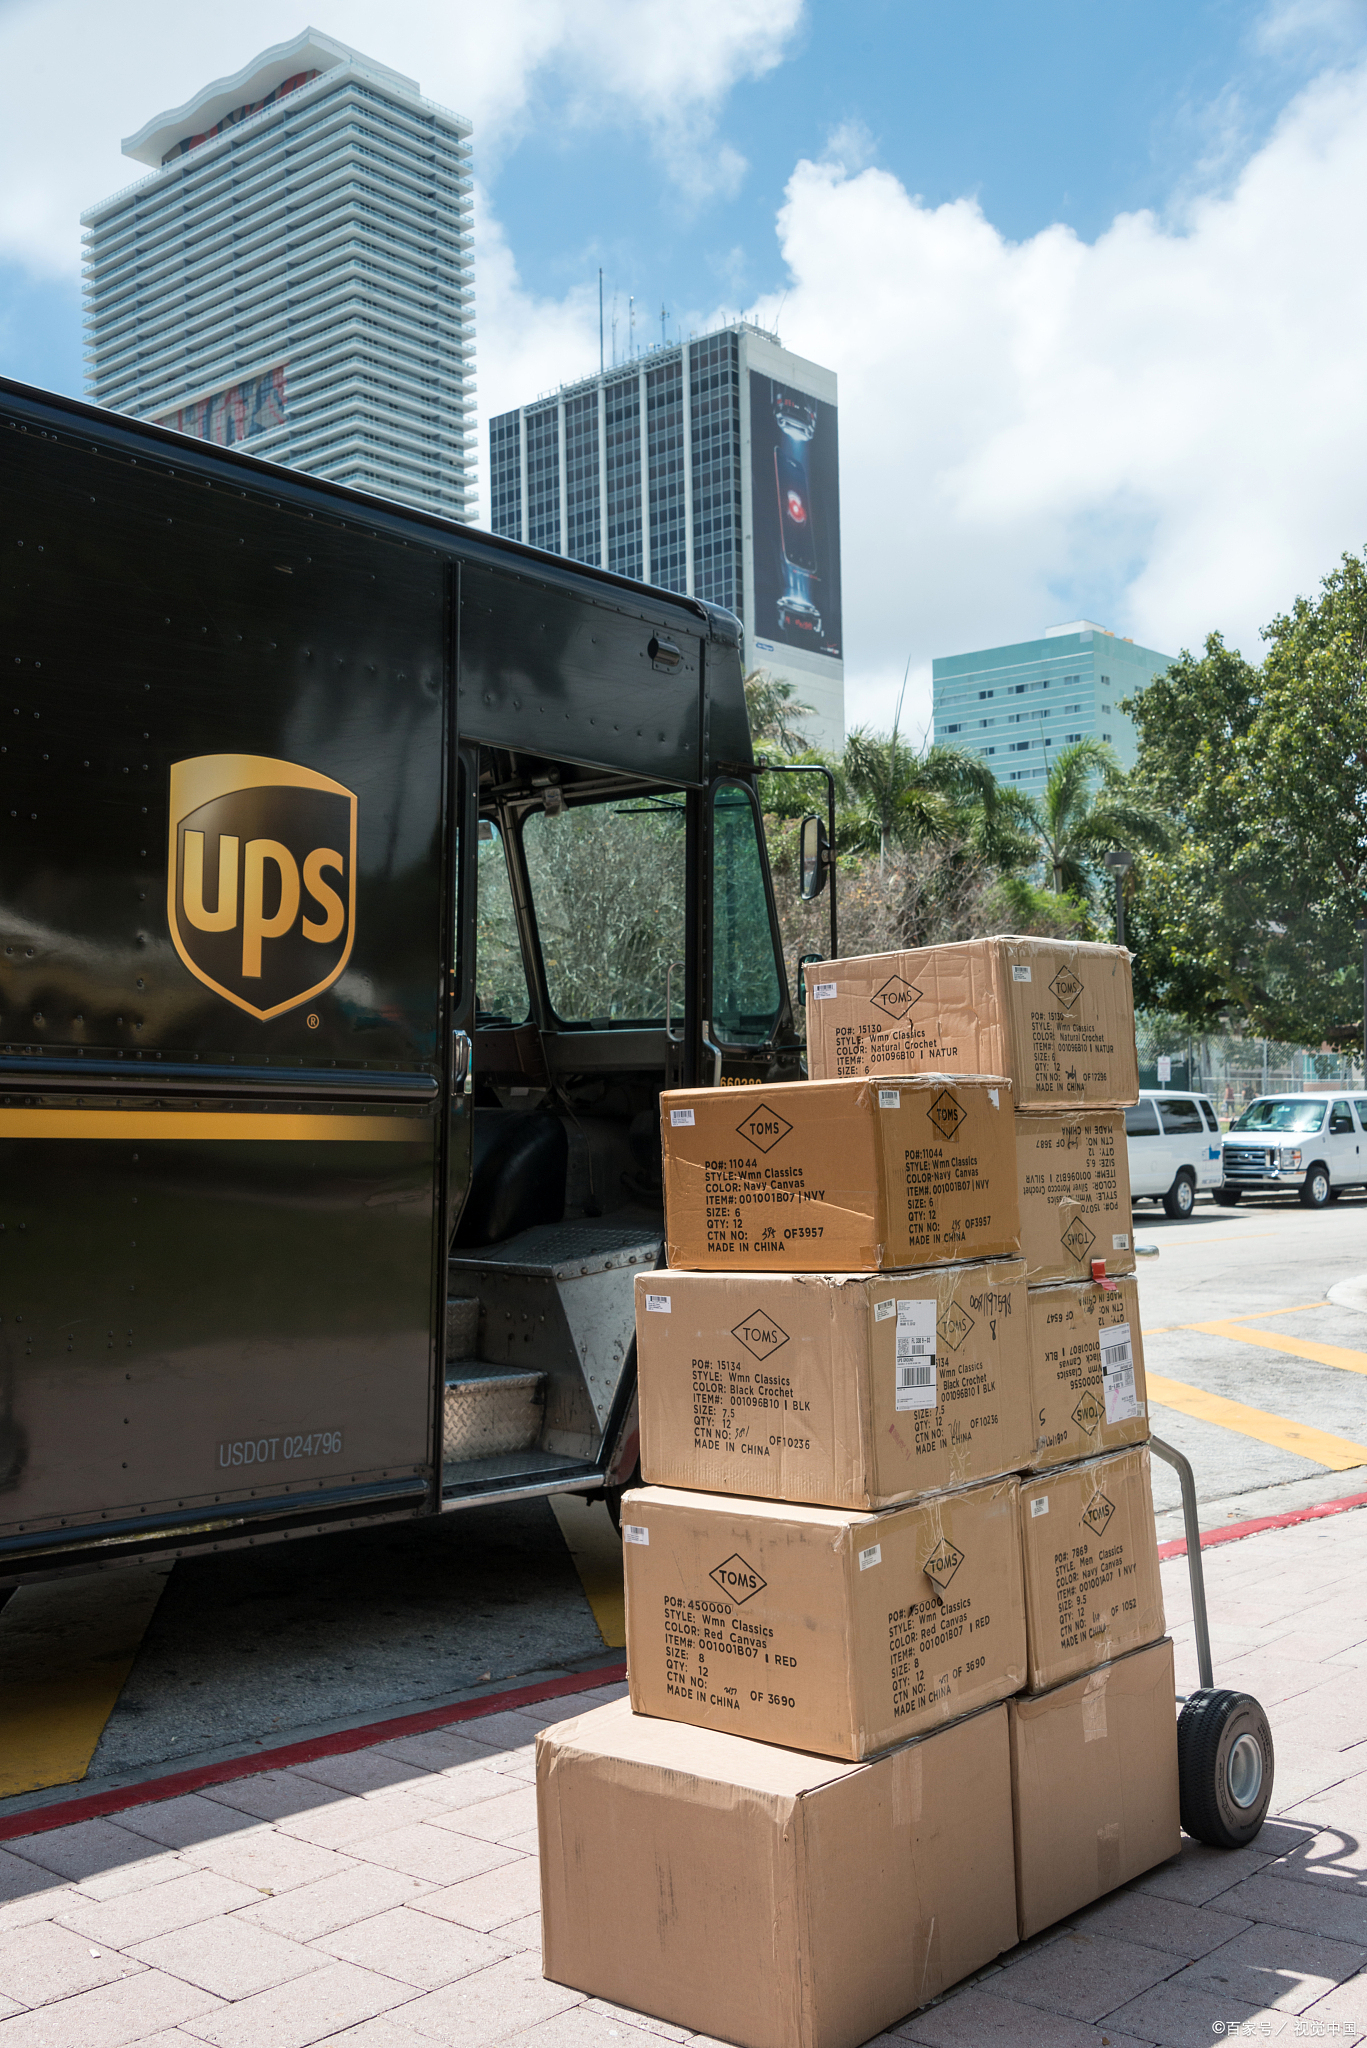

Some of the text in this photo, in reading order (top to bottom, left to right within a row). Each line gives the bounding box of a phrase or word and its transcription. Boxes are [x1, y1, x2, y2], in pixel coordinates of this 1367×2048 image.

[183, 829, 344, 978] ups
[880, 991, 912, 1006] TOMS
[836, 1024, 882, 1036] PO#: 15130
[870, 1030, 925, 1042] Wmn Classics
[1082, 1034, 1104, 1042] Crochet
[837, 1040, 937, 1056] COLOR: Natural Crochet
[871, 1047, 958, 1062] 001096B10 NATUR
[838, 1067, 858, 1075] SIZE:
[1036, 1083, 1084, 1091] MADE CHINA
[937, 1109, 958, 1120] TOMS
[750, 1122, 779, 1135] TOMS
[705, 1161, 726, 1170] PO#:
[932, 1156, 977, 1170] Wmn Classics
[705, 1167, 803, 1181] STYLE: Wmn Classics
[955, 1169, 978, 1178] Canvas
[1026, 1175, 1044, 1183] SILVR
[706, 1179, 804, 1192] COLOR: Navy Canvas
[933, 1180, 989, 1195] 001001B07 NVY
[1023, 1183, 1088, 1195] Silver Morocco Crochet
[706, 1190, 825, 1205] ITEM#: 001001B07 NVY
[908, 1199, 926, 1209] SIZE:
[706, 1208, 730, 1217] SIZE:
[1081, 1204, 1100, 1213] 15070
[707, 1219, 742, 1228] QTY: 12
[909, 1212, 925, 1221] QTY:
[909, 1223, 923, 1233] CTN
[708, 1231, 747, 1240] CTN NO:
[910, 1232, 966, 1246] MADE IN CHINA
[1068, 1233, 1089, 1246] TOMS
[708, 1242, 785, 1252] MADE IN CHINA
[1107, 1292, 1122, 1301] MADE
[1047, 1311, 1073, 1323] OF 6547
[942, 1319, 966, 1334] TOMS
[743, 1328, 777, 1343] TOMS
[1045, 1352, 1058, 1361] BLK
[1059, 1355, 1081, 1368] Canvas
[692, 1359, 741, 1370] PO#: 15134
[959, 1362, 983, 1374] Classics
[692, 1371, 790, 1386] STYLE: Wmn Classics
[1057, 1367, 1082, 1380] Classics
[944, 1374, 987, 1390] Black Crochet
[693, 1382, 793, 1398] COLOR: Black Crochet
[941, 1382, 995, 1402] 001096B10 BLK
[694, 1393, 810, 1411] ITEM#: 001096B10 BLK
[694, 1405, 716, 1415] SIZE:
[1077, 1407, 1099, 1421] TOMS
[694, 1416, 714, 1426] QTY:
[694, 1428, 712, 1437] CTN
[716, 1430, 731, 1439] NO:
[220, 1432, 341, 1466] USDOT 024796
[695, 1439, 770, 1456] MADE IN CHINA
[916, 1438, 947, 1454] MADE IN
[1072, 1545, 1088, 1558] 7869
[1080, 1545, 1123, 1567] Men Classics
[930, 1553, 957, 1573] TOMS
[1082, 1557, 1122, 1581] Navy Canvas
[1124, 1563, 1136, 1576] NVY
[719, 1570, 756, 1588] TOMS
[664, 1596, 731, 1614] PO#: 450000
[1058, 1600, 1073, 1613] SIZE:
[1122, 1599, 1136, 1612] 1052
[665, 1608, 773, 1637] STYLE: Wmn Classics
[889, 1599, 971, 1638] STYLE: Wmn Classics
[665, 1621, 767, 1648] COLOR: Red Canvas
[890, 1613, 967, 1651] COLOR: Red Canvas
[890, 1616, 990, 1665] ITEM#: 001001B07 RED
[1061, 1635, 1078, 1649] MADE
[666, 1633, 797, 1667] ITEM#: 001001B07 RED
[666, 1647, 688, 1660] SIZE:
[667, 1659, 708, 1677] QTY: 12
[953, 1667, 962, 1679] OF
[966, 1656, 985, 1672] 3690
[667, 1671, 685, 1684] CTN
[691, 1676, 707, 1689] NO:
[750, 1691, 763, 1702] OF
[768, 1694, 795, 1708] 3690
[667, 1684, 740, 1710] MADE IN CHINA
[894, 1685, 951, 1718] MADE IN CHINA
